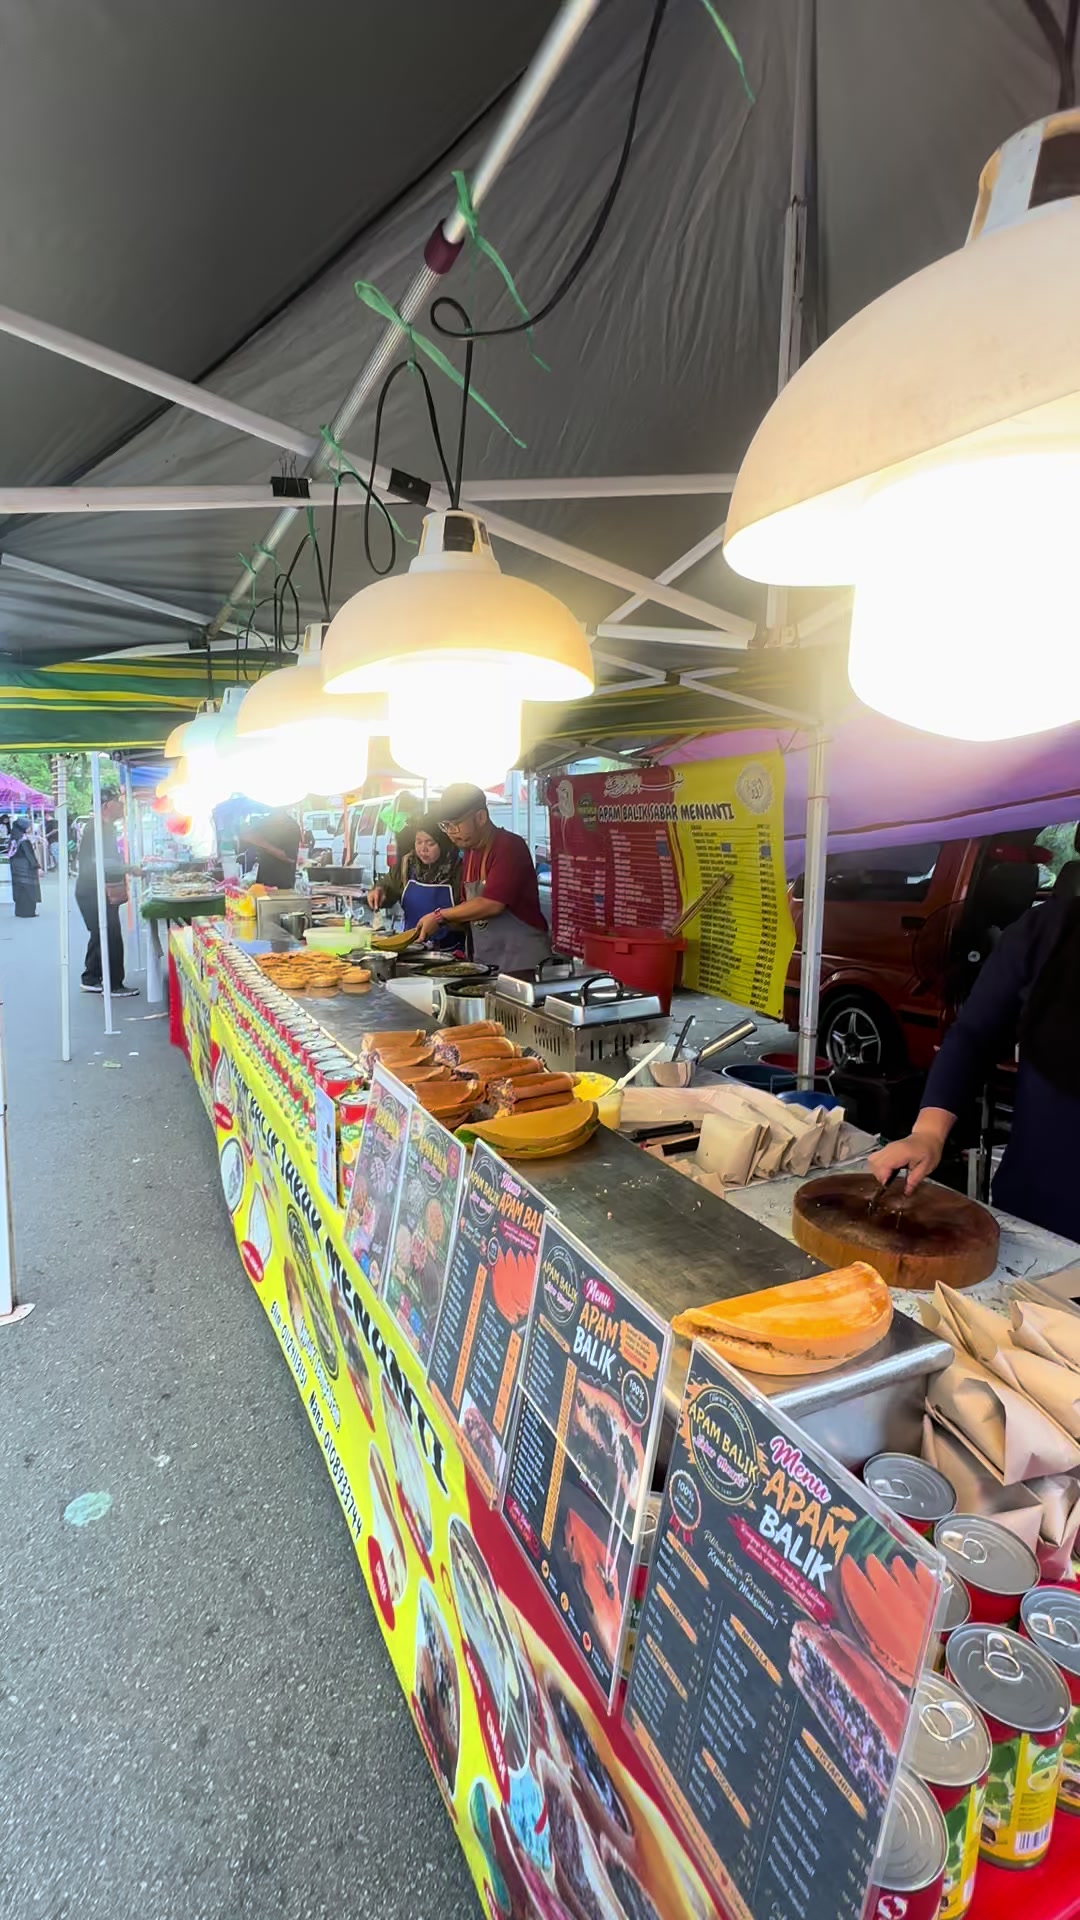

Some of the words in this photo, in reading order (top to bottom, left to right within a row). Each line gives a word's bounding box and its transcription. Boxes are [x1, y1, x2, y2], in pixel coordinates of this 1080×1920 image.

[599, 804, 621, 822] APAM
[623, 803, 649, 822] BALIK
[650, 803, 678, 822] SABAR
[680, 803, 734, 820] MENANTI
[498, 1191, 525, 1224] APAM
[543, 1260, 560, 1282] APAM
[559, 1276, 577, 1303] BALIK
[585, 1279, 611, 1308] Menu
[579, 1301, 619, 1348] APAM
[325, 1236, 448, 1495] MENANTI
[573, 1325, 616, 1381] BALIK
[629, 1378, 645, 1402] 100%
[689, 1402, 721, 1444] APAM
[721, 1433, 757, 1484] BALIK
[770, 1436, 831, 1503] Menu
[677, 1479, 695, 1503] 100%
[762, 1469, 850, 1566] APAM
[759, 1504, 832, 1592] BALIK
[741, 1629, 768, 1667] NUTELLA
[789, 1757, 811, 1793] Pistachio
[794, 1738, 816, 1773] Pistachio
[815, 1745, 854, 1800] PISTACHIO
[785, 1776, 807, 1812] Pistachio
